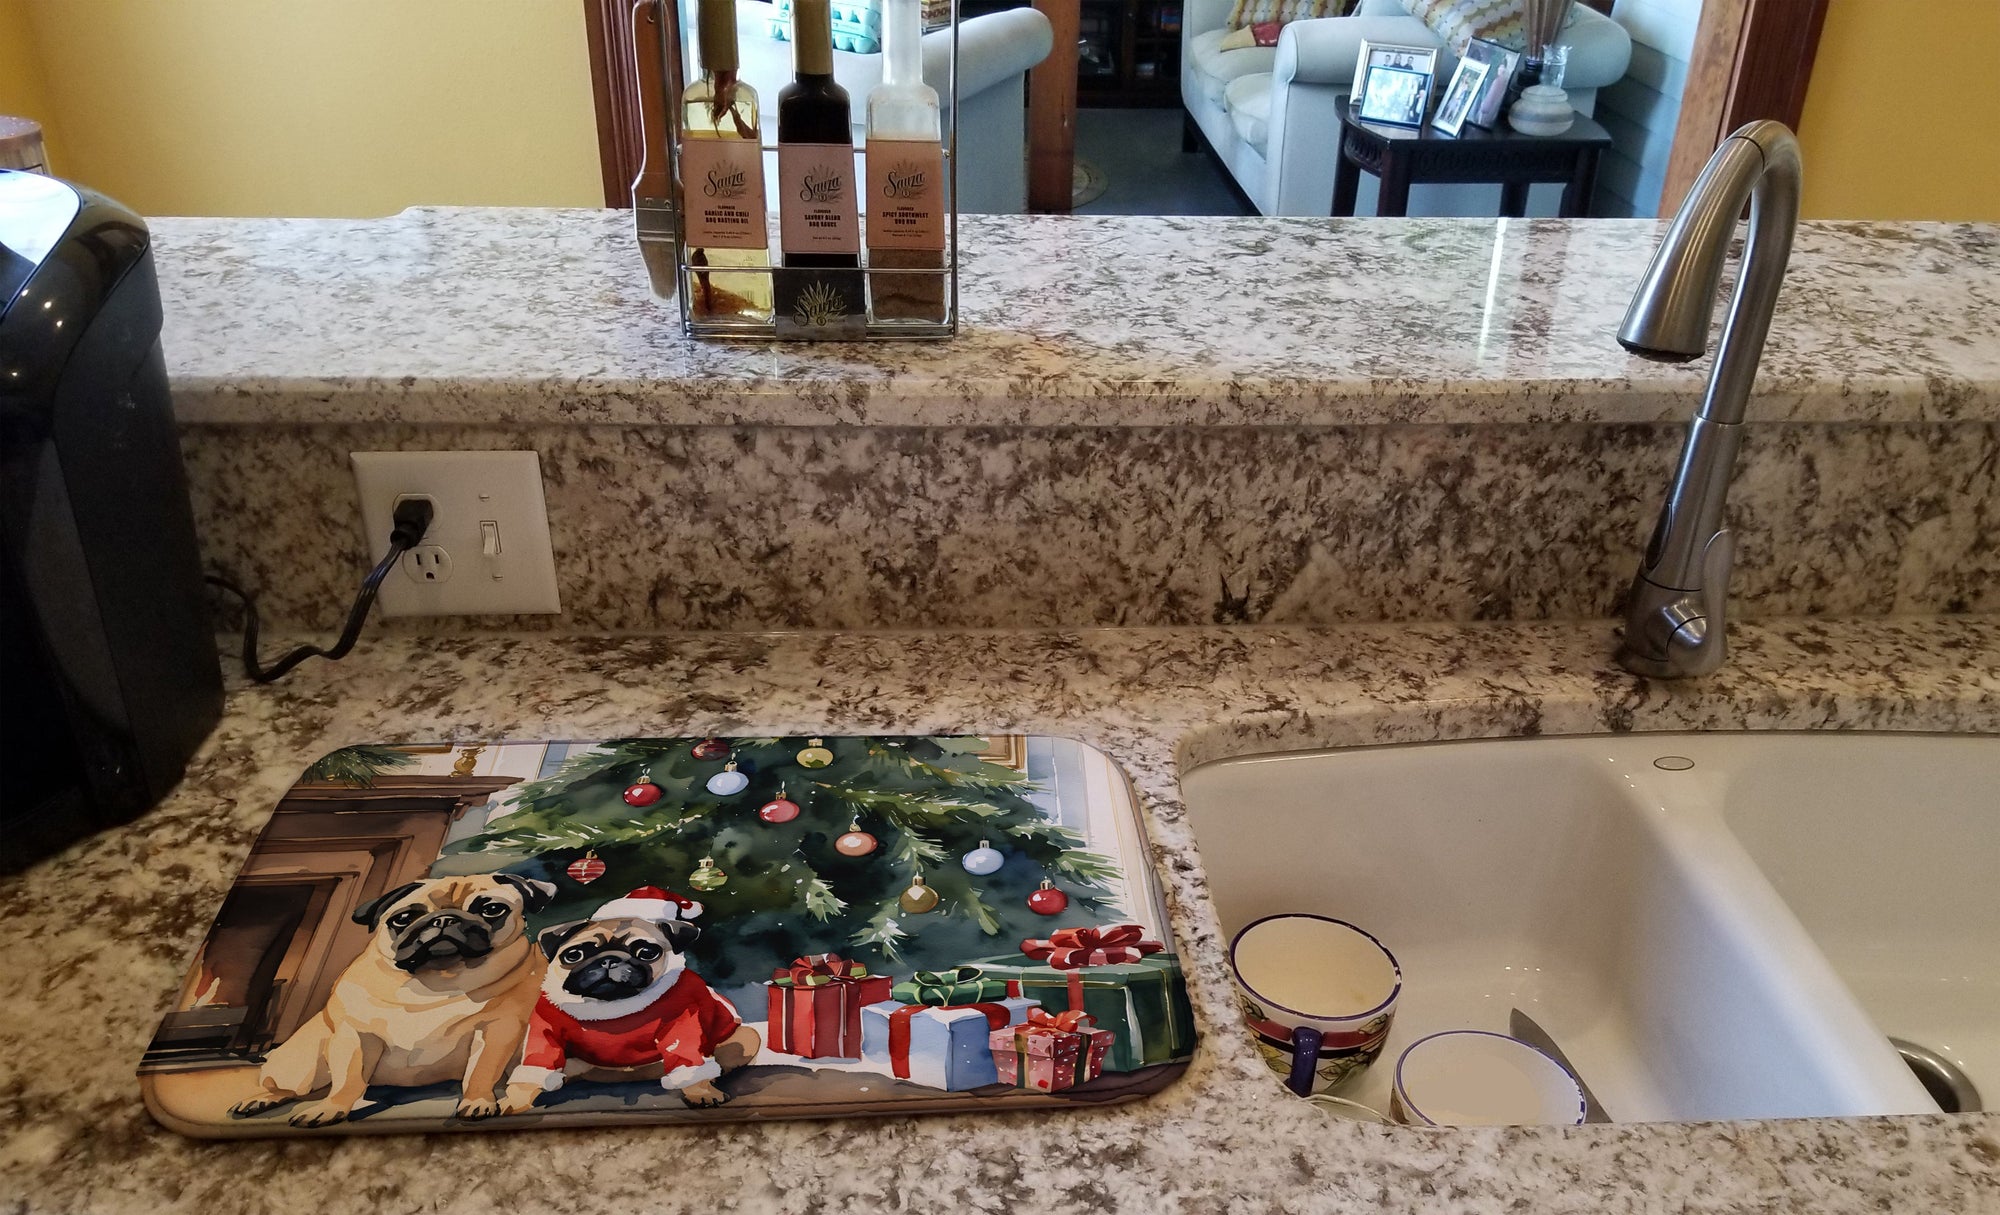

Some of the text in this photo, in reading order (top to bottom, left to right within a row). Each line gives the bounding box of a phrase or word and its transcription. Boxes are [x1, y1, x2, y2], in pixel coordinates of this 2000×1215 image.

[703, 169, 745, 197] Sauza
[800, 175, 842, 202] Sauza
[883, 170, 924, 198] Sauza
[793, 295, 843, 327] Sauza
